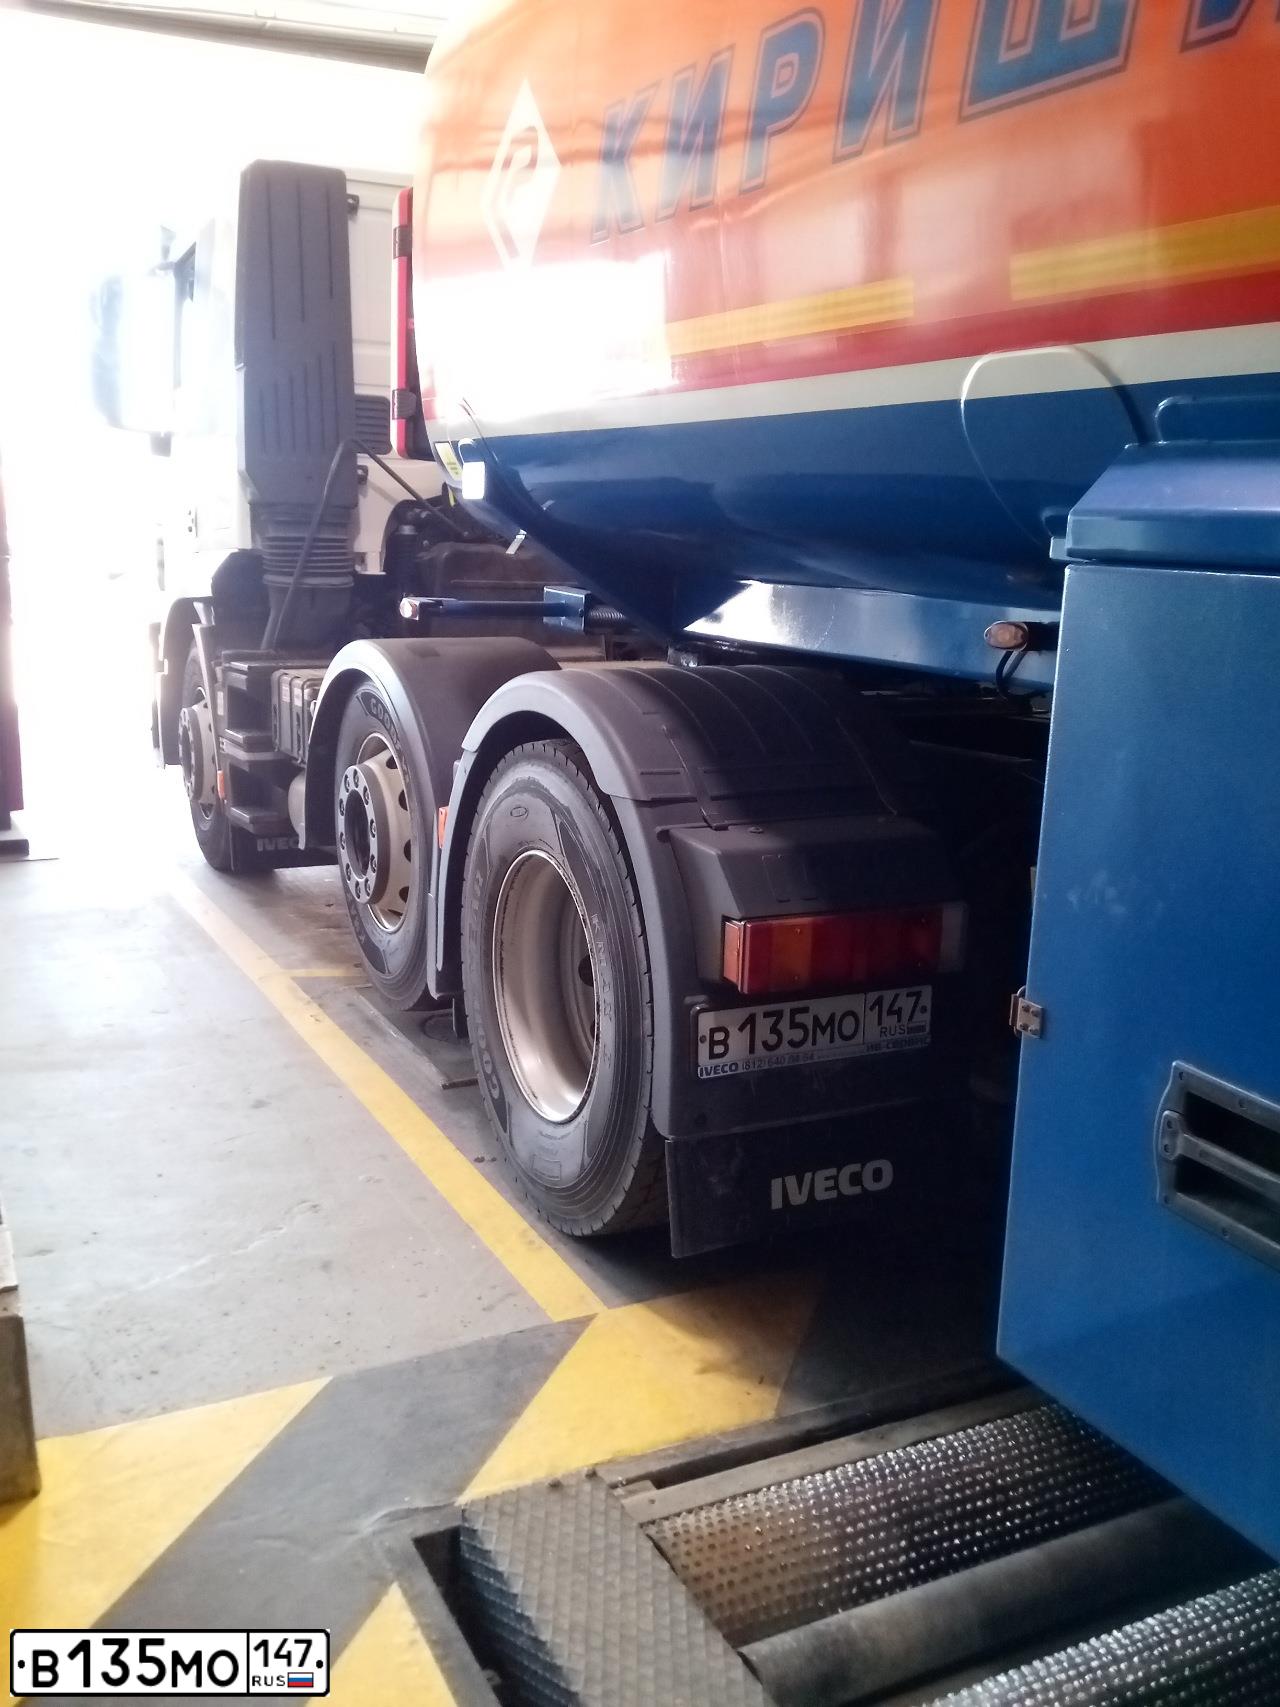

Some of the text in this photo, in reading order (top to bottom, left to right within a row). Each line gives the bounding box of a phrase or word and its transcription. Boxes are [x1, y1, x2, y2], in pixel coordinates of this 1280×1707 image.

[256, 837, 298, 852] IVEC
[708, 1006, 860, 1060] В135МО
[869, 990, 922, 1026] 147
[880, 1024, 906, 1038] RUS
[699, 1062, 739, 1078] IVECO
[771, 1159, 894, 1210] IVECO
